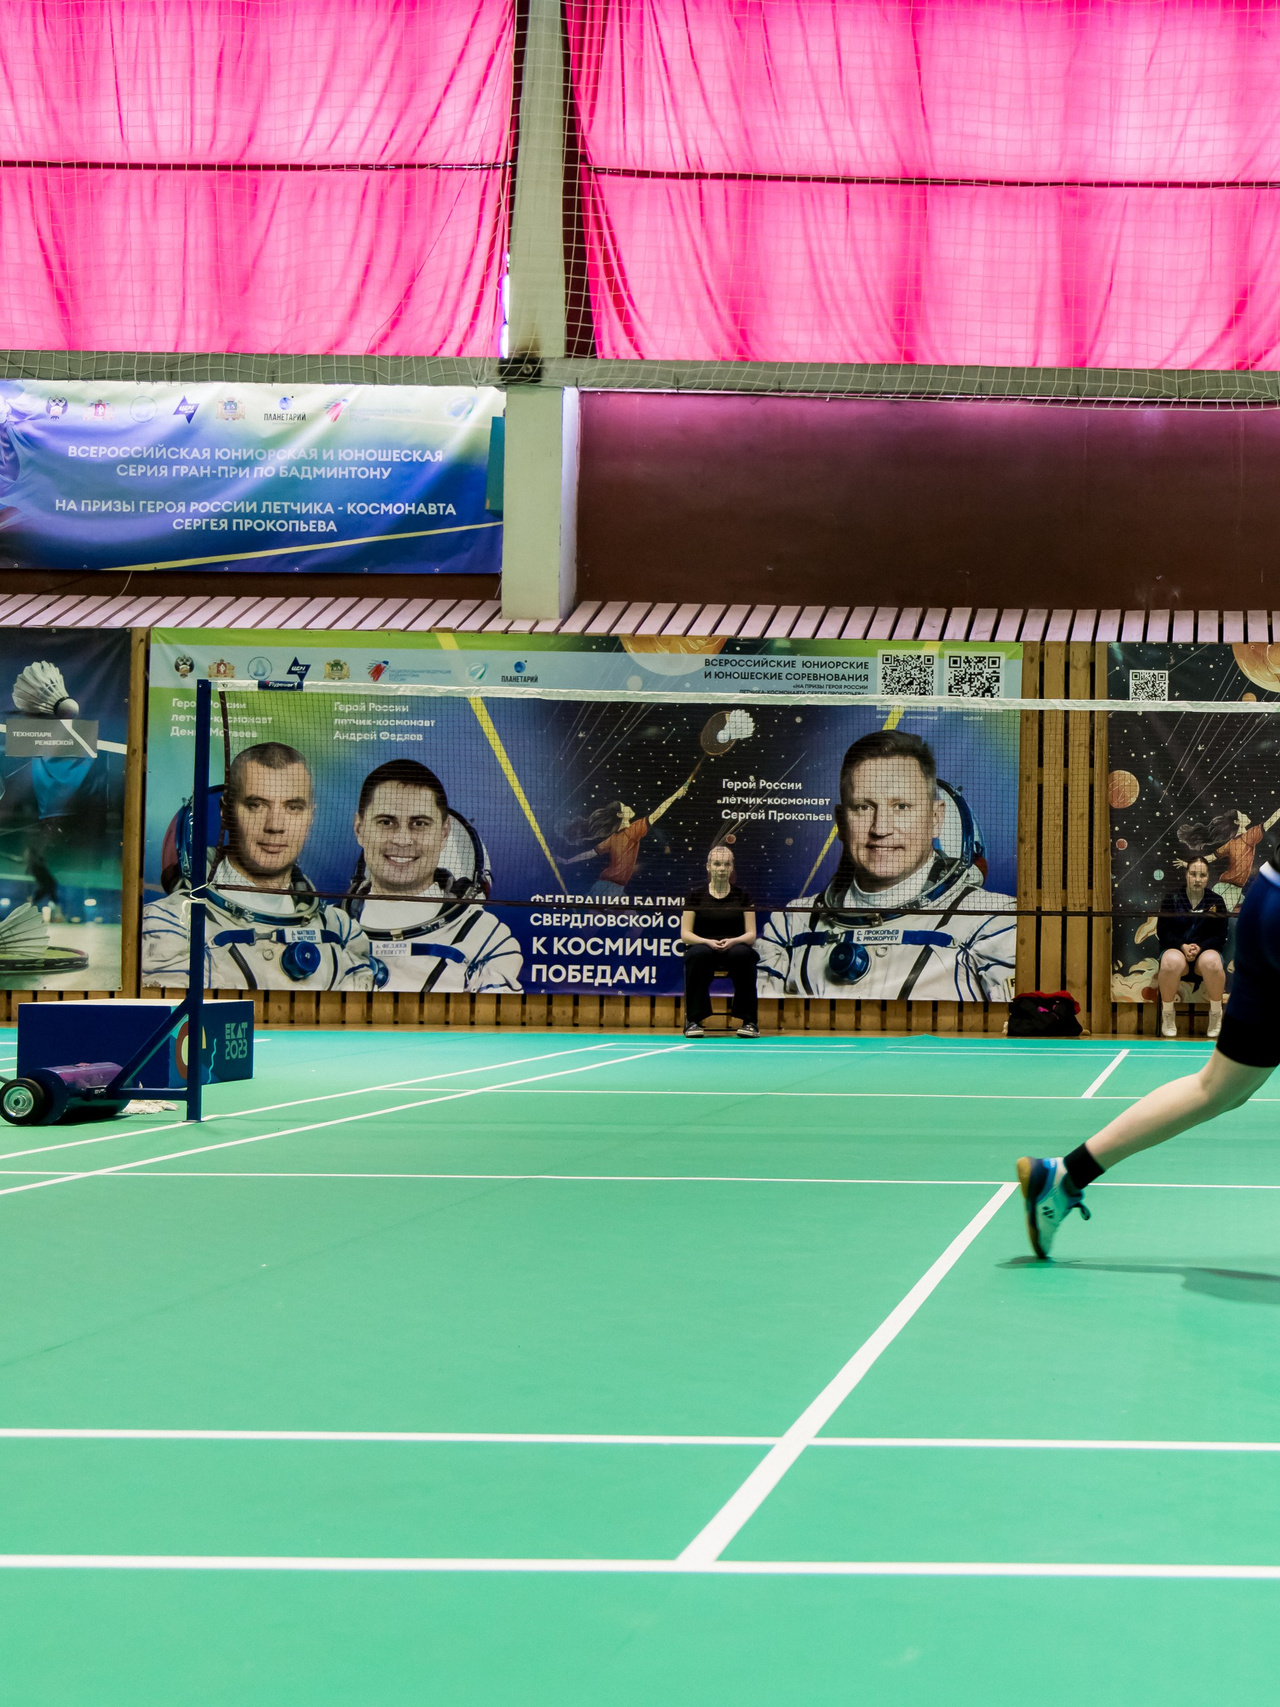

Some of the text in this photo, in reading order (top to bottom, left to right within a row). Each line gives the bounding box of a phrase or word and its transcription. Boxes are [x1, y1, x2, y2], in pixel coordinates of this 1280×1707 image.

[263, 412, 307, 422] ПЛАНЕТАРИЙ
[68, 444, 443, 463] ВСЕРОССИЙСКАЯ ЮНИОРСКАЯ И ЮНОШЕСКАЯ
[116, 464, 392, 481] СЕРИЯ ГРАН-ПРИ ПО БАДМИНТОНУ
[55, 499, 78, 512] НА
[81, 499, 135, 513] ПРИЗЫ
[139, 500, 186, 514] ГЕРОЯ
[189, 501, 257, 514] РОССИИ
[260, 501, 335, 515] ЛЕТЧИКА
[347, 502, 457, 516] КОСМОНАВТА
[172, 518, 338, 533] СЕРГЕЯ ПРОКОПЬЕВА
[704, 658, 870, 670] ВСЕРОССИЙСКИЕ ЮНИОРСКИЕ
[501, 675, 539, 683] ПЛАНЕТАРИЙ
[704, 671, 869, 682] И ЮНОШЕСКИЕ СОРЕВНОВАНИЯ
[171, 698, 196, 710] Геро
[334, 702, 409, 713] Герой России
[34, 738, 74, 746] РЕЖЕВСКОЙ
[333, 730, 423, 742] Андрей Федяев
[722, 778, 803, 791] Герой России
[721, 809, 833, 823] Сергей Прокопьев
[530, 912, 664, 929] СВЕРДЛОВСКОЙ
[532, 936, 685, 957] К КОСМИЧЕС
[531, 964, 657, 987] ПОБЕДАМ!
[225, 1022, 248, 1040] EKAT
[225, 1039, 248, 1060] 2023
